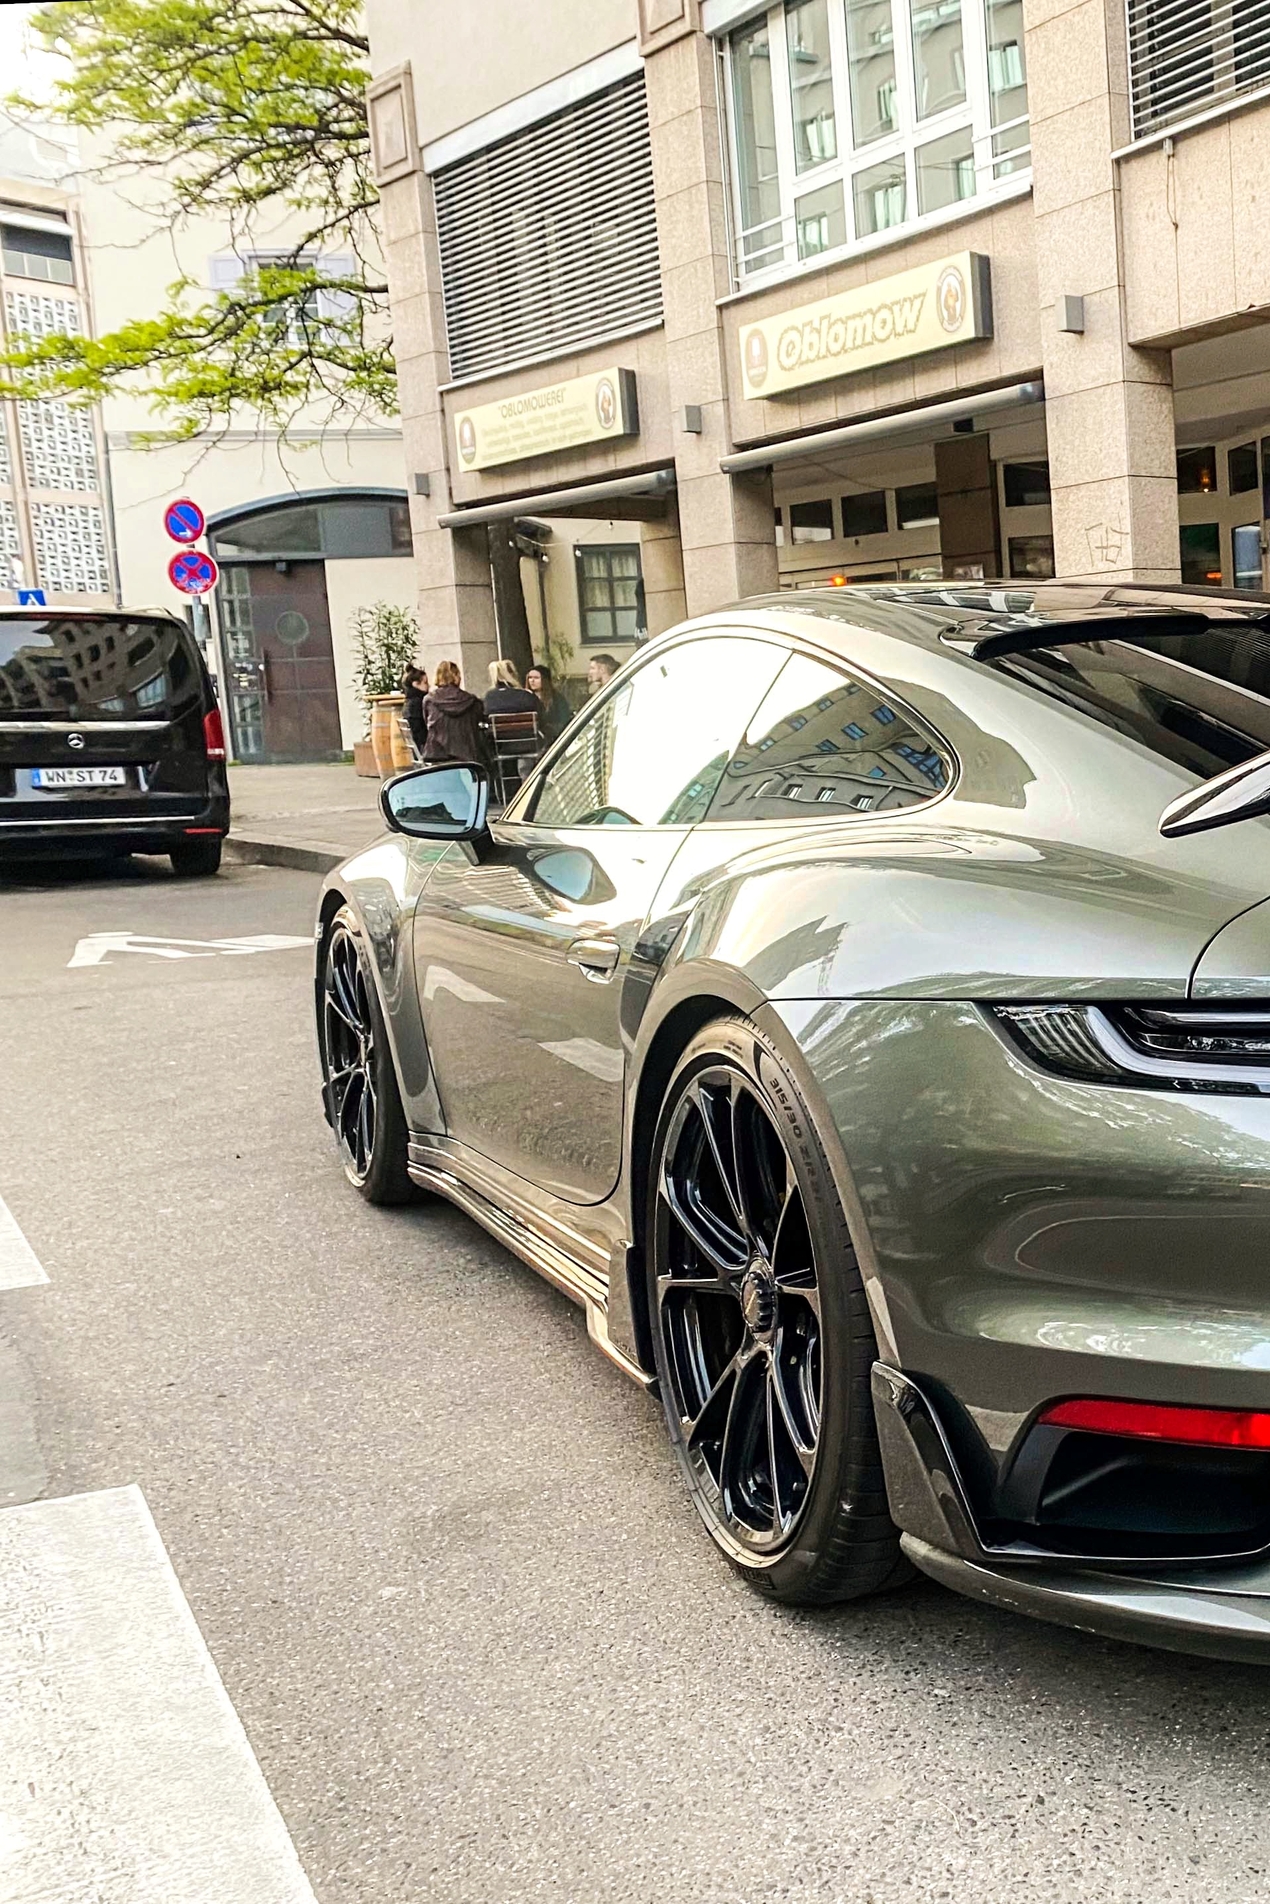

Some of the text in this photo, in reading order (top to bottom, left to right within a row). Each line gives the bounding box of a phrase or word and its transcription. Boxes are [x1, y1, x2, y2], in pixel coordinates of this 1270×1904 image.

[777, 289, 928, 371] Oblomow
[45, 770, 66, 783] WN
[76, 770, 95, 782] ST
[98, 769, 118, 782] 74
